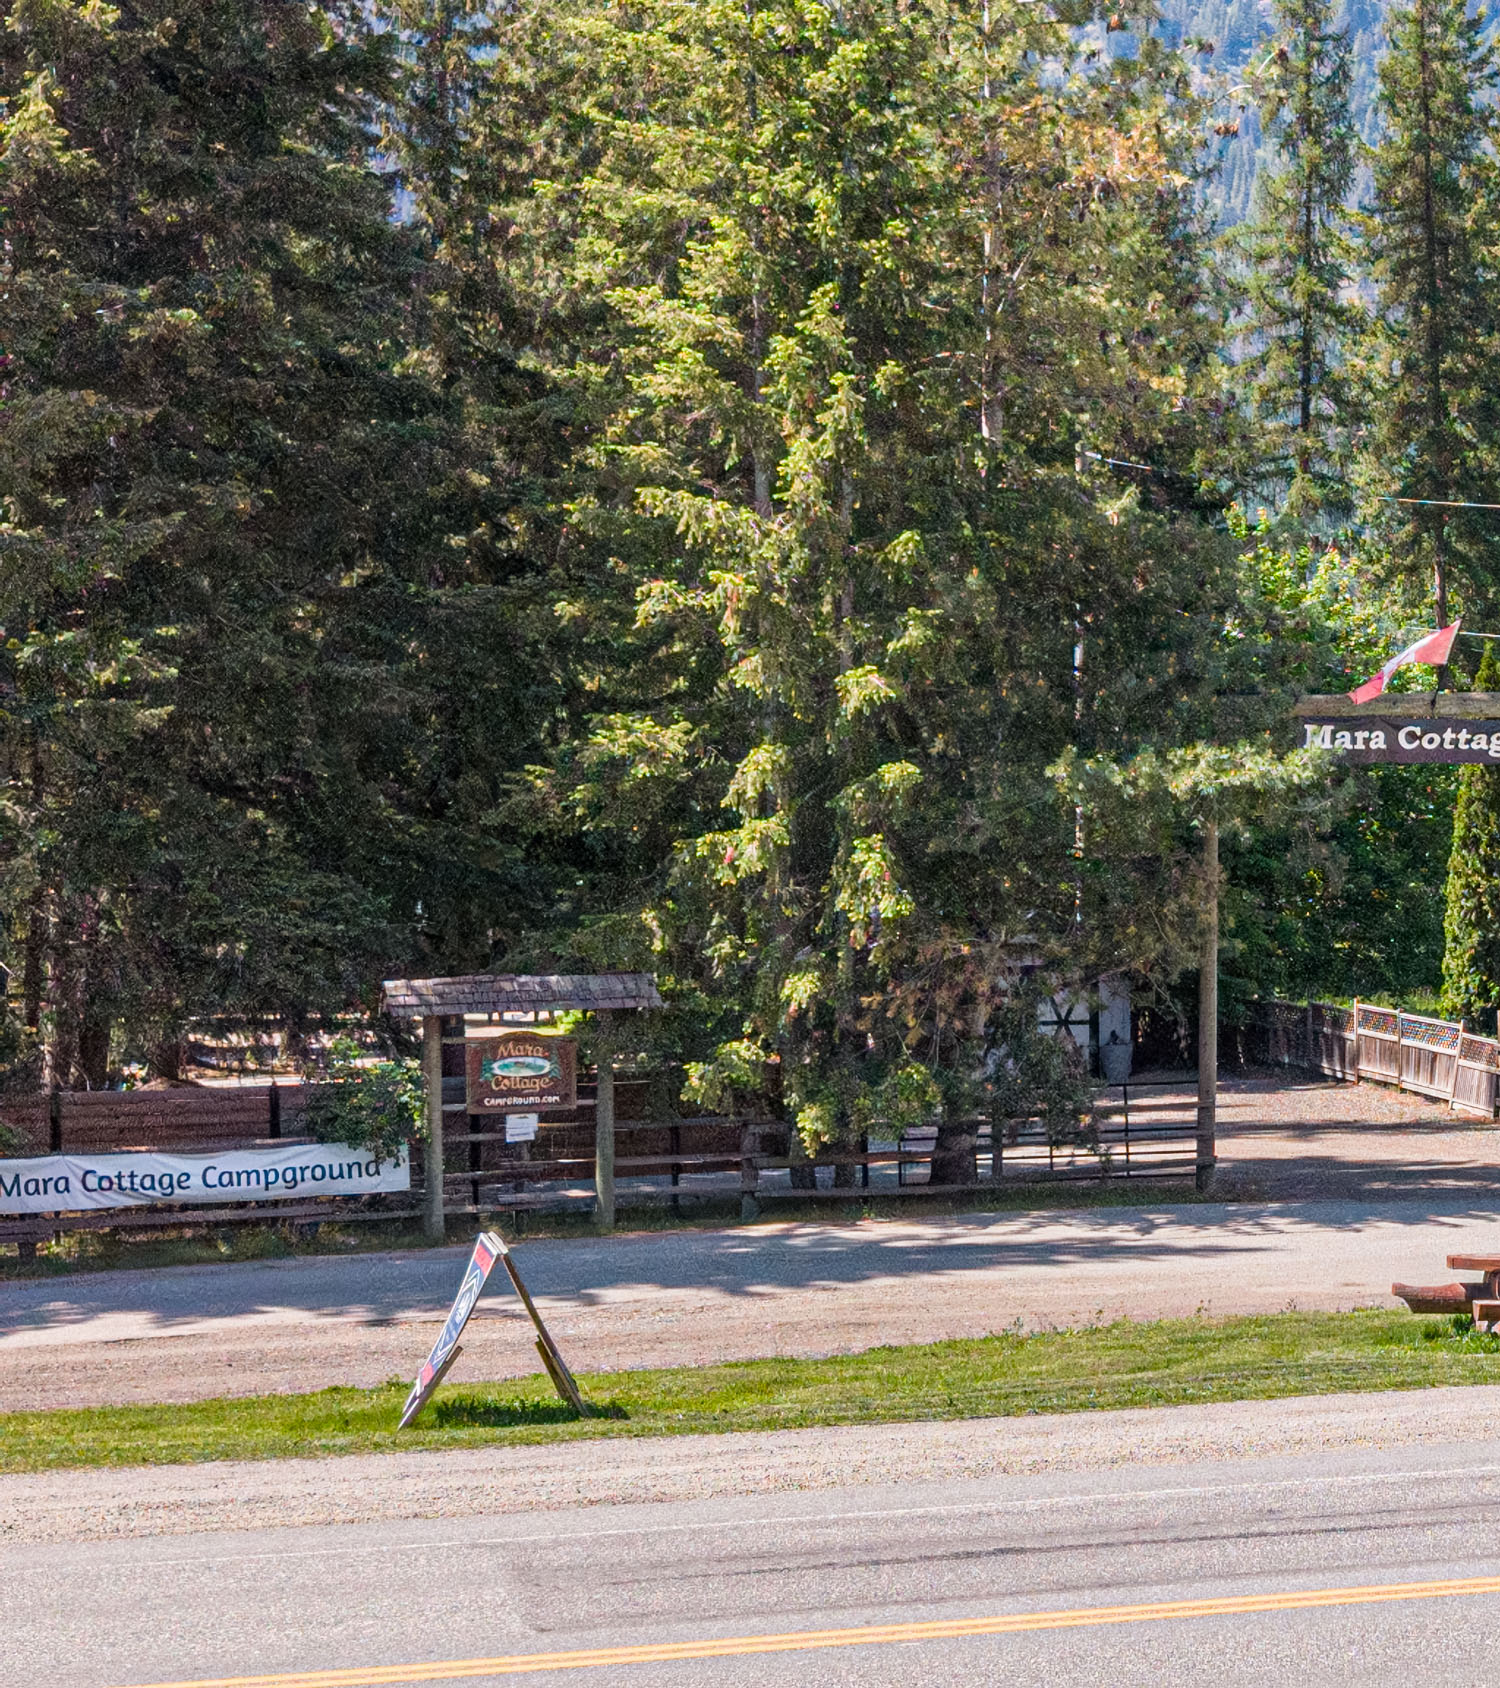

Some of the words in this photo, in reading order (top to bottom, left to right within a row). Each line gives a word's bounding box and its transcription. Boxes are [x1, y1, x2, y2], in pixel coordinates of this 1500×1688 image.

[1304, 724, 1387, 750] Mara
[497, 1041, 544, 1060] Mara
[491, 1075, 554, 1093] Cottage
[0, 1173, 71, 1197] Mara
[81, 1169, 192, 1197] Cottage
[201, 1160, 381, 1191] Campground
